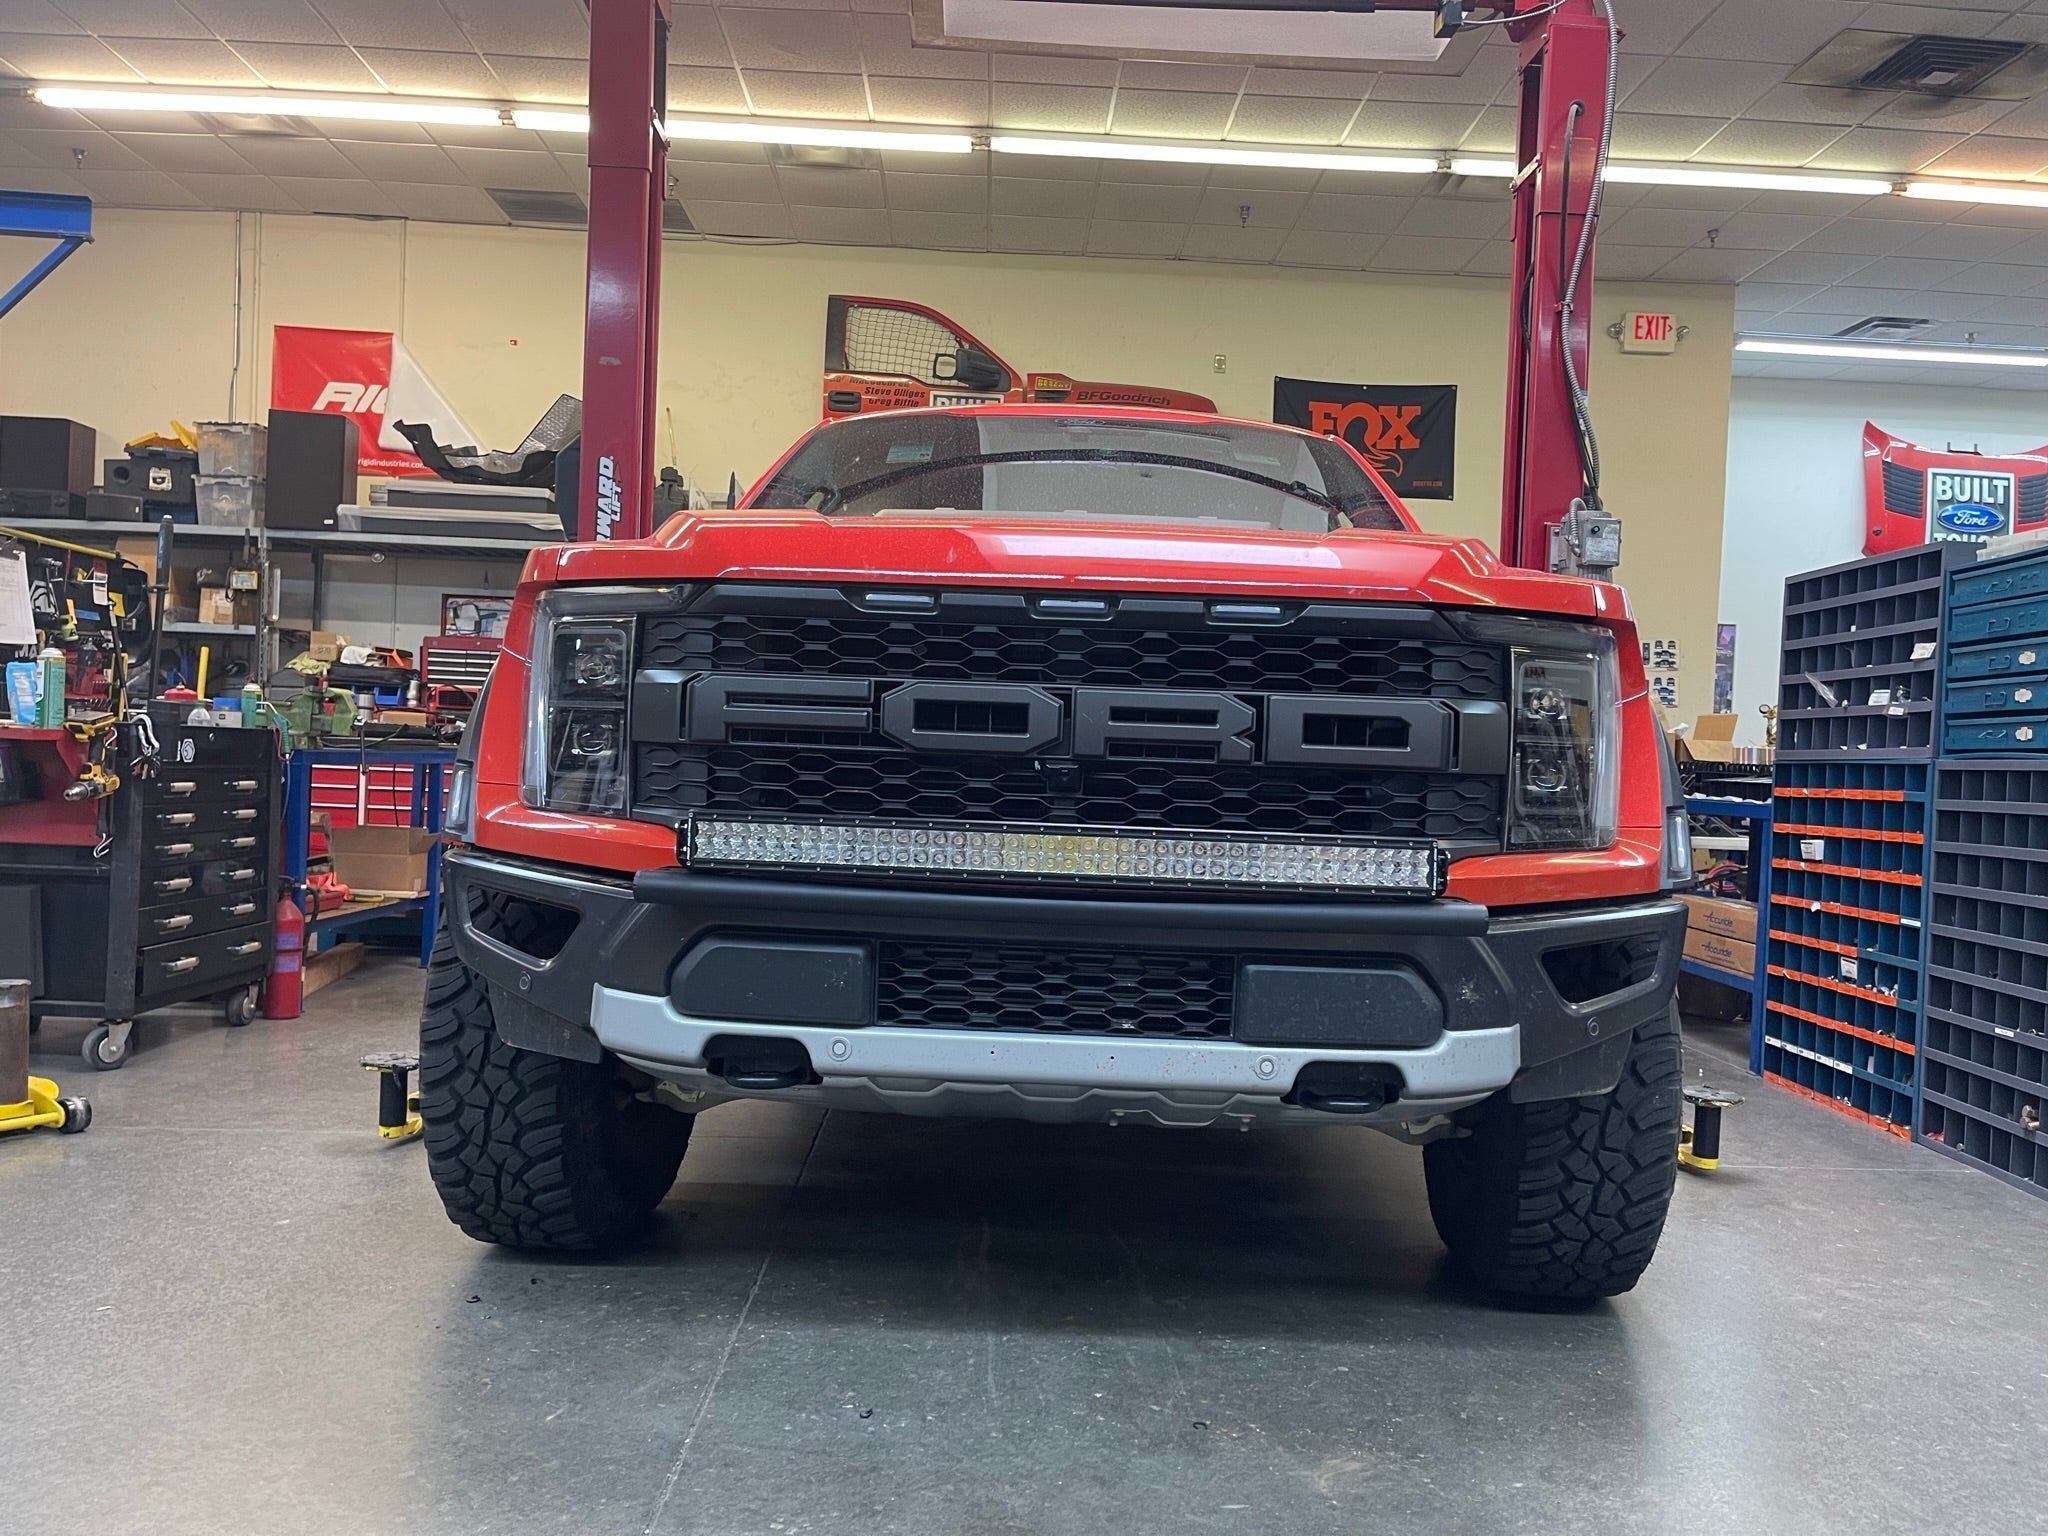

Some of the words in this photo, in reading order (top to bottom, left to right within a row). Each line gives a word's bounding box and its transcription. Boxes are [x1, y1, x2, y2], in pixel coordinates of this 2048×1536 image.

[1634, 314, 1670, 341] EXIT
[864, 386, 892, 396] Steve
[1076, 391, 1171, 407] BFGoodrich
[1308, 401, 1422, 450] FOX
[611, 481, 622, 522] LIFT
[1935, 475, 2009, 504] BUILT
[1953, 509, 1989, 527] Ford
[687, 673, 1453, 772] FORD
